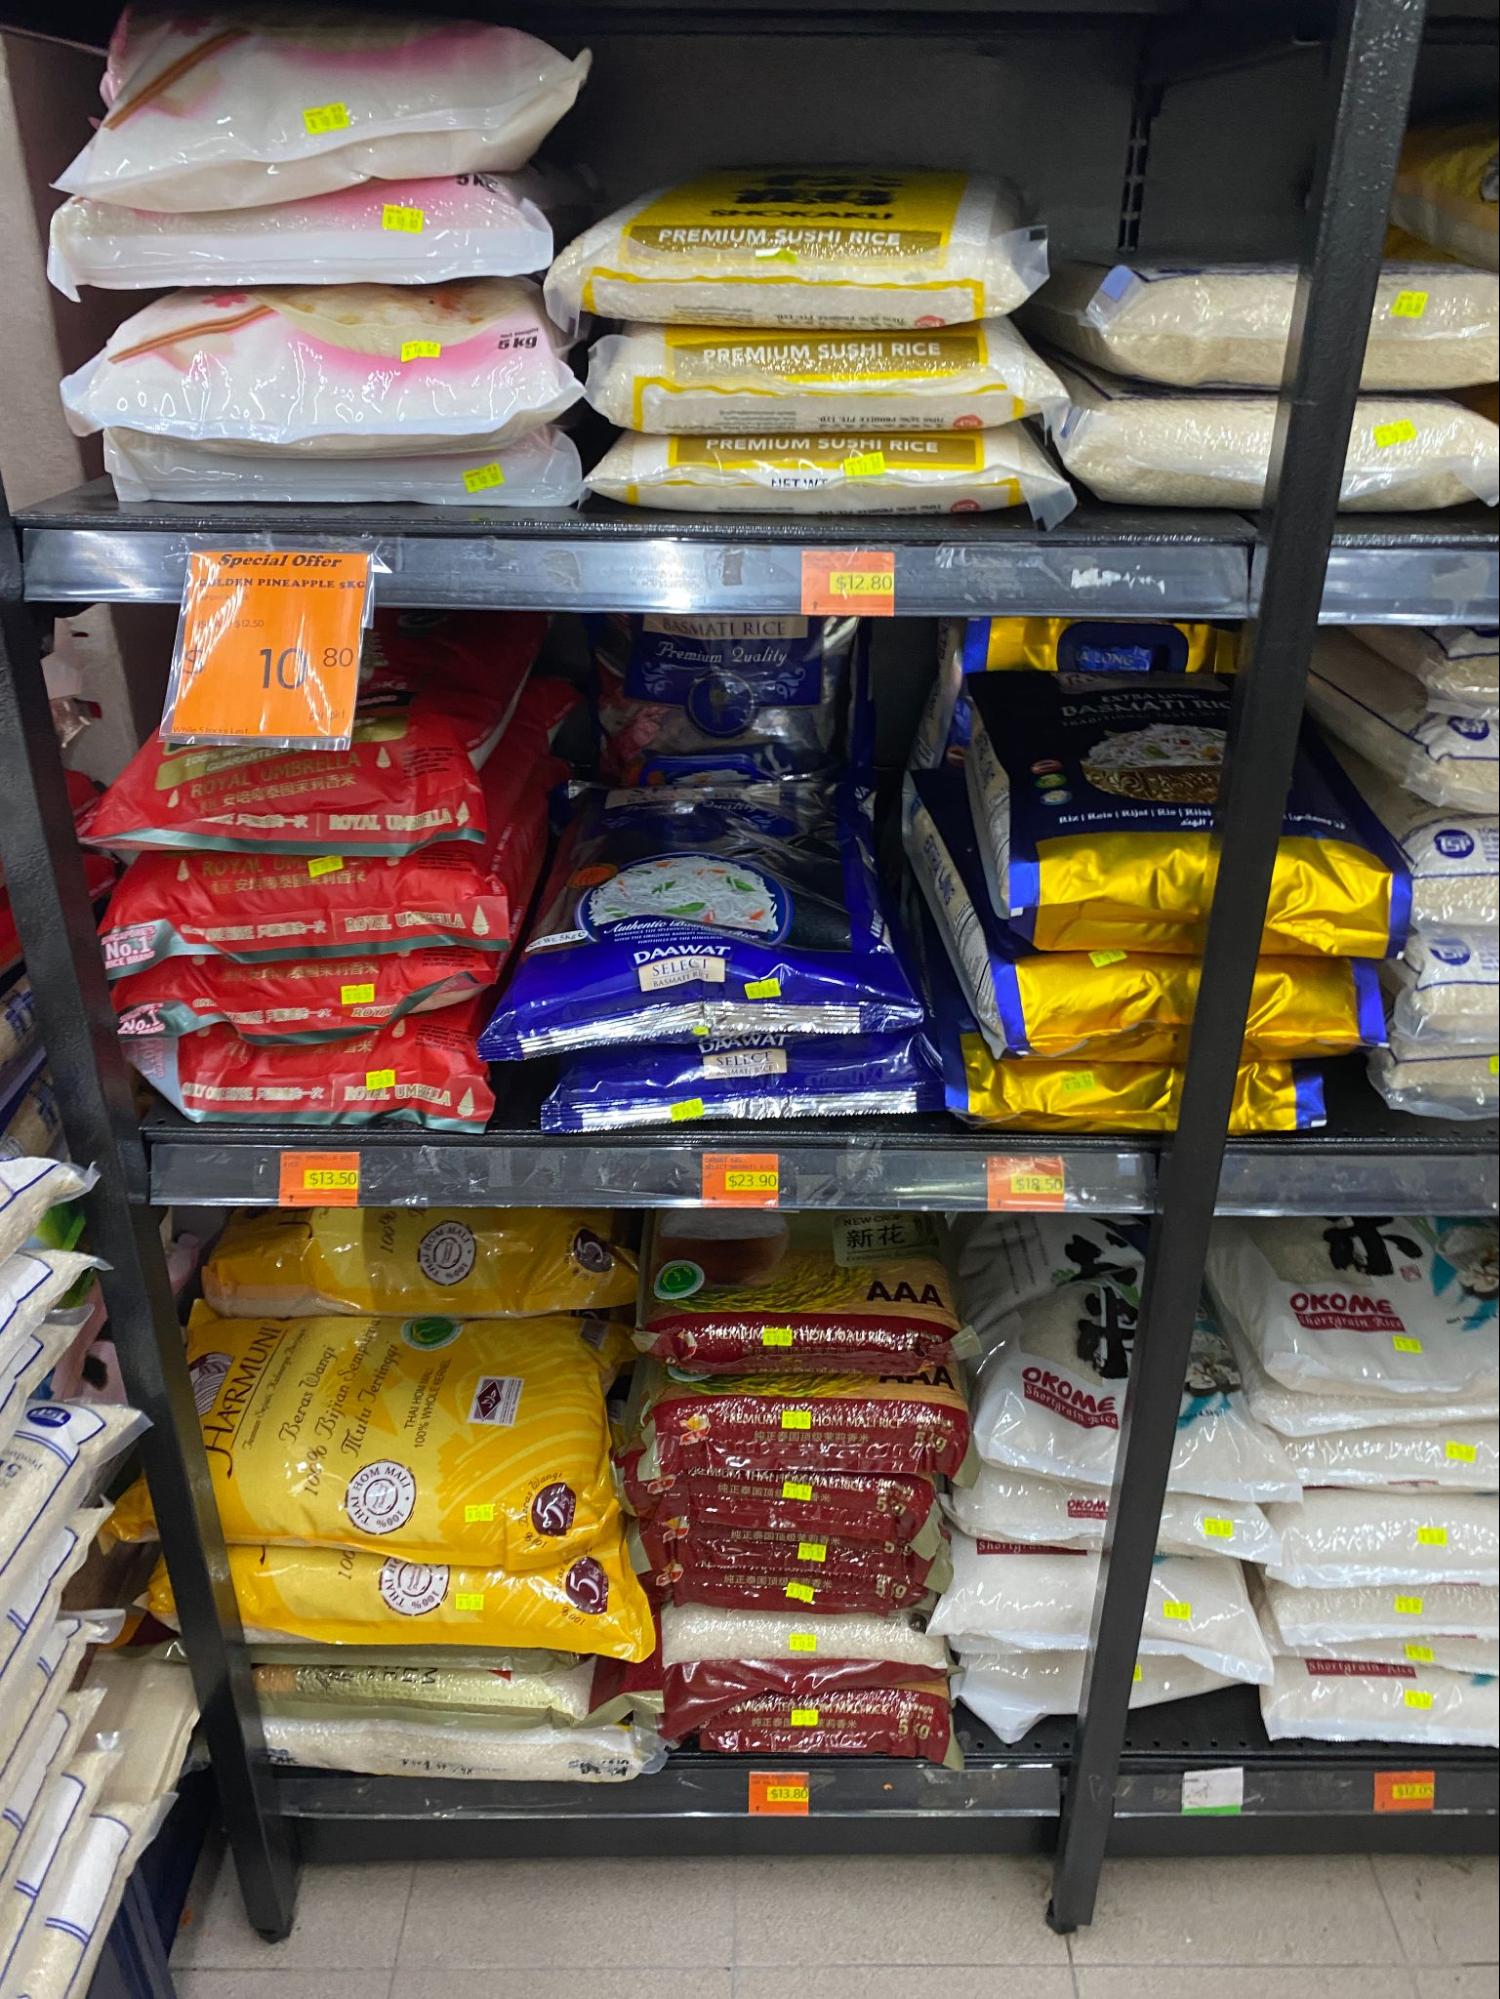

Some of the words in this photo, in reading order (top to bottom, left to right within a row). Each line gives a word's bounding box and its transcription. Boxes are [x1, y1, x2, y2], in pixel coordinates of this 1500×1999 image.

[658, 227, 767, 244] PREMIUM
[774, 228, 842, 245] SUSHI
[849, 231, 901, 247] RICE
[498, 338, 512, 350] 5
[511, 334, 538, 350] kg
[702, 345, 810, 365] PREMIUM
[816, 343, 884, 361] SUSHI
[890, 341, 942, 358] RICE
[705, 437, 810, 451] PREMIUM
[816, 437, 883, 451] SUSHI
[888, 440, 939, 454] RICE
[218, 553, 288, 569] Special
[291, 555, 342, 569] Offer
[257, 578, 335, 589] PINEAPPLE
[836, 574, 893, 592] $12.80
[662, 619, 737, 637] BASMATI
[742, 620, 787, 636] RICE
[655, 640, 723, 663] Premium
[731, 646, 789, 667] Quality
[259, 648, 308, 691] 10
[323, 648, 354, 668] 80
[1193, 699, 1231, 711] RIC
[105, 935, 155, 961] No.1
[634, 944, 732, 965] DAAWAT
[652, 958, 709, 977] SELECT
[119, 1009, 162, 1033] No.1
[698, 1033, 789, 1054] DAAWAT
[716, 1051, 771, 1066] SELECT
[308, 1171, 358, 1188] $13.50
[728, 1173, 778, 1189] $23.90
[846, 1223, 906, 1249] 新花
[866, 1280, 945, 1309] AAA
[1289, 1292, 1396, 1315] OKOME
[356, 1340, 402, 1403] Tertinggi
[278, 1392, 315, 1444] Beras
[297, 1344, 339, 1389] Wangi
[1022, 1366, 1117, 1413] OKOME
[202, 1326, 282, 1479] HARMUNI
[313, 1384, 352, 1440] Bijian
[403, 1403, 420, 1431] THAI
[722, 1412, 778, 1426] PREMIUM
[811, 1414, 847, 1427] HOM
[340, 1406, 373, 1459] Mutu
[413, 1420, 430, 1449] 100%
[353, 1466, 381, 1492] HOM
[384, 1466, 412, 1489] MALI
[350, 1495, 370, 1526] THAI
[876, 1497, 887, 1513] 5
[1067, 1499, 1107, 1511] OKOM
[337, 1550, 356, 1581] 100
[385, 1577, 405, 1608] THAI
[569, 1571, 600, 1605] 5
[898, 1718, 909, 1736] 5
[770, 1786, 809, 1800] $13.80
